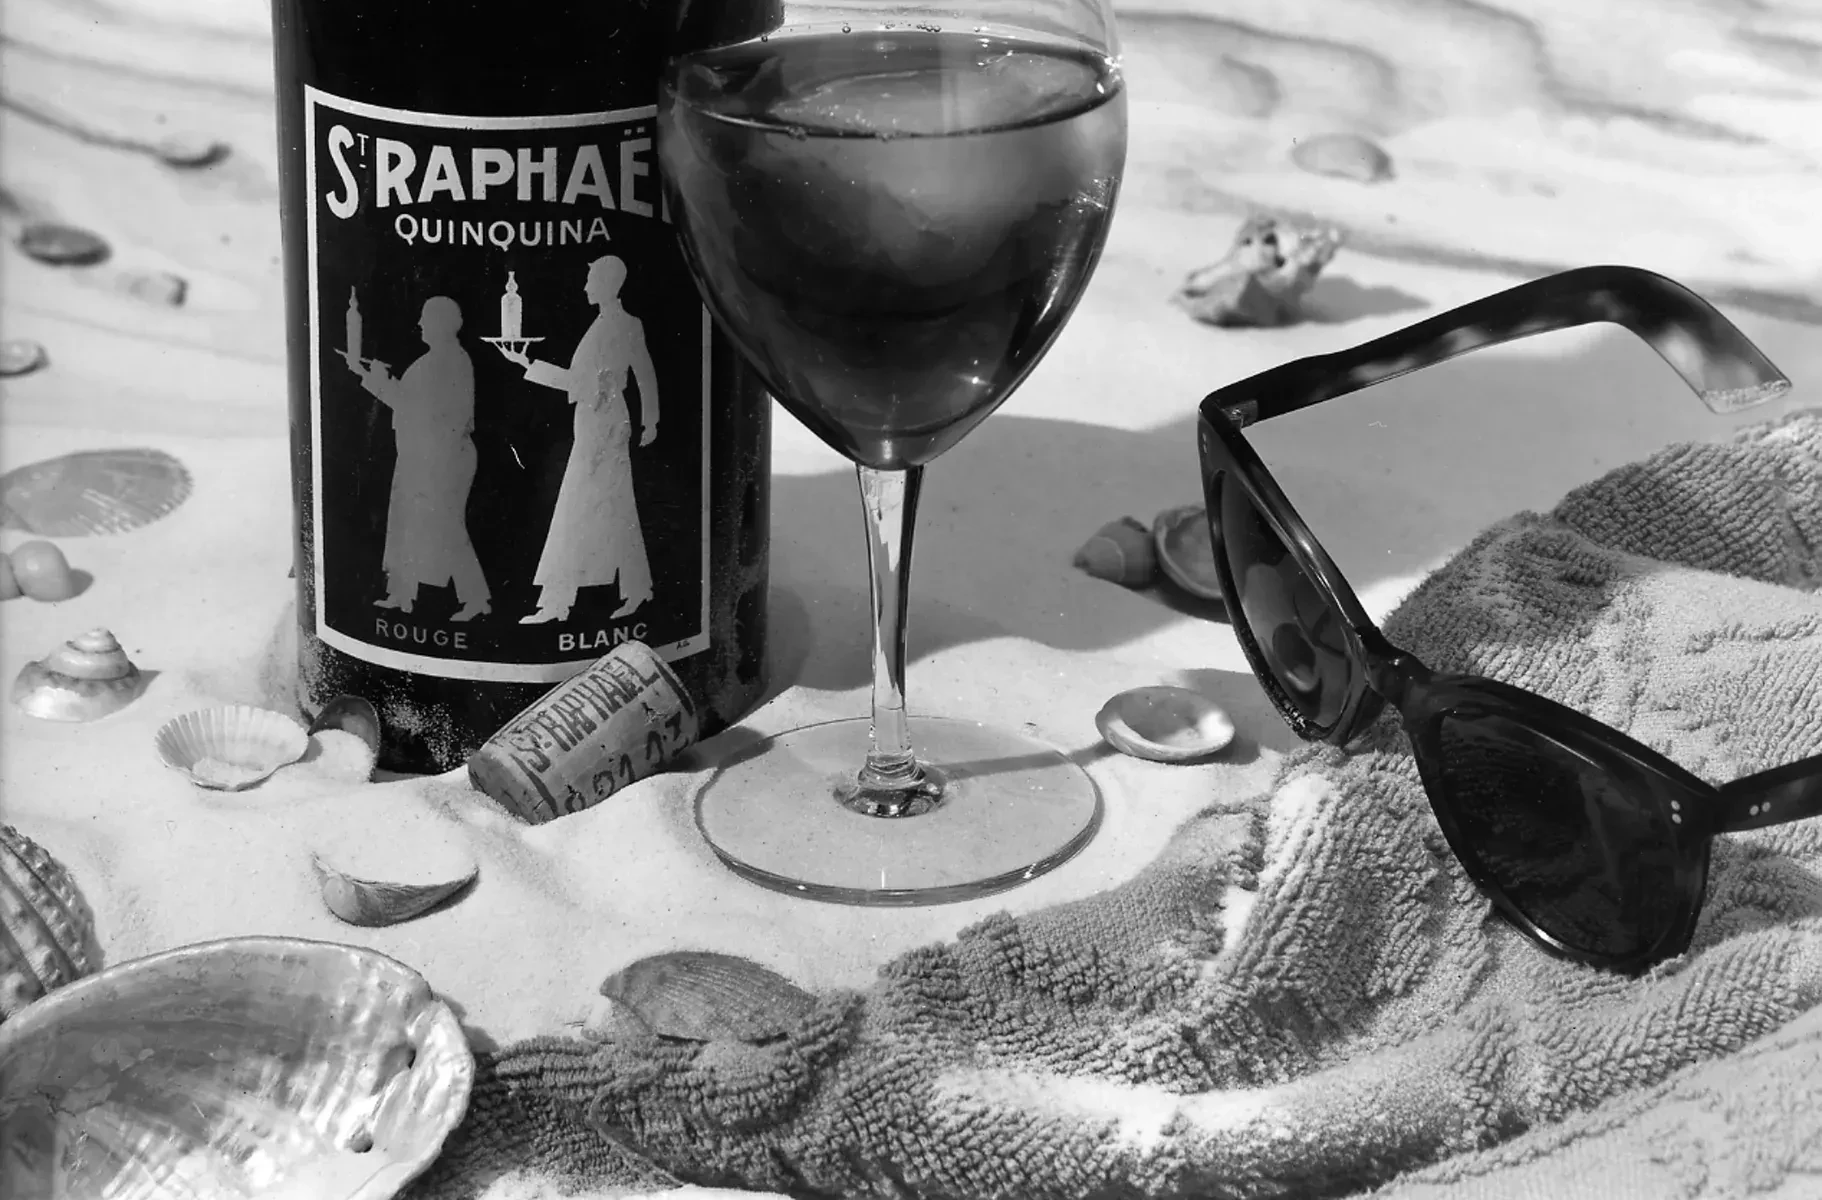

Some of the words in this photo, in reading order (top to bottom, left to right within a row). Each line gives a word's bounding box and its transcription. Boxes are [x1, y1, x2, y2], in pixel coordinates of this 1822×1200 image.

[394, 213, 611, 252] QUINQUINA
[375, 618, 469, 650] ROUGE
[558, 623, 648, 651] BLANC
